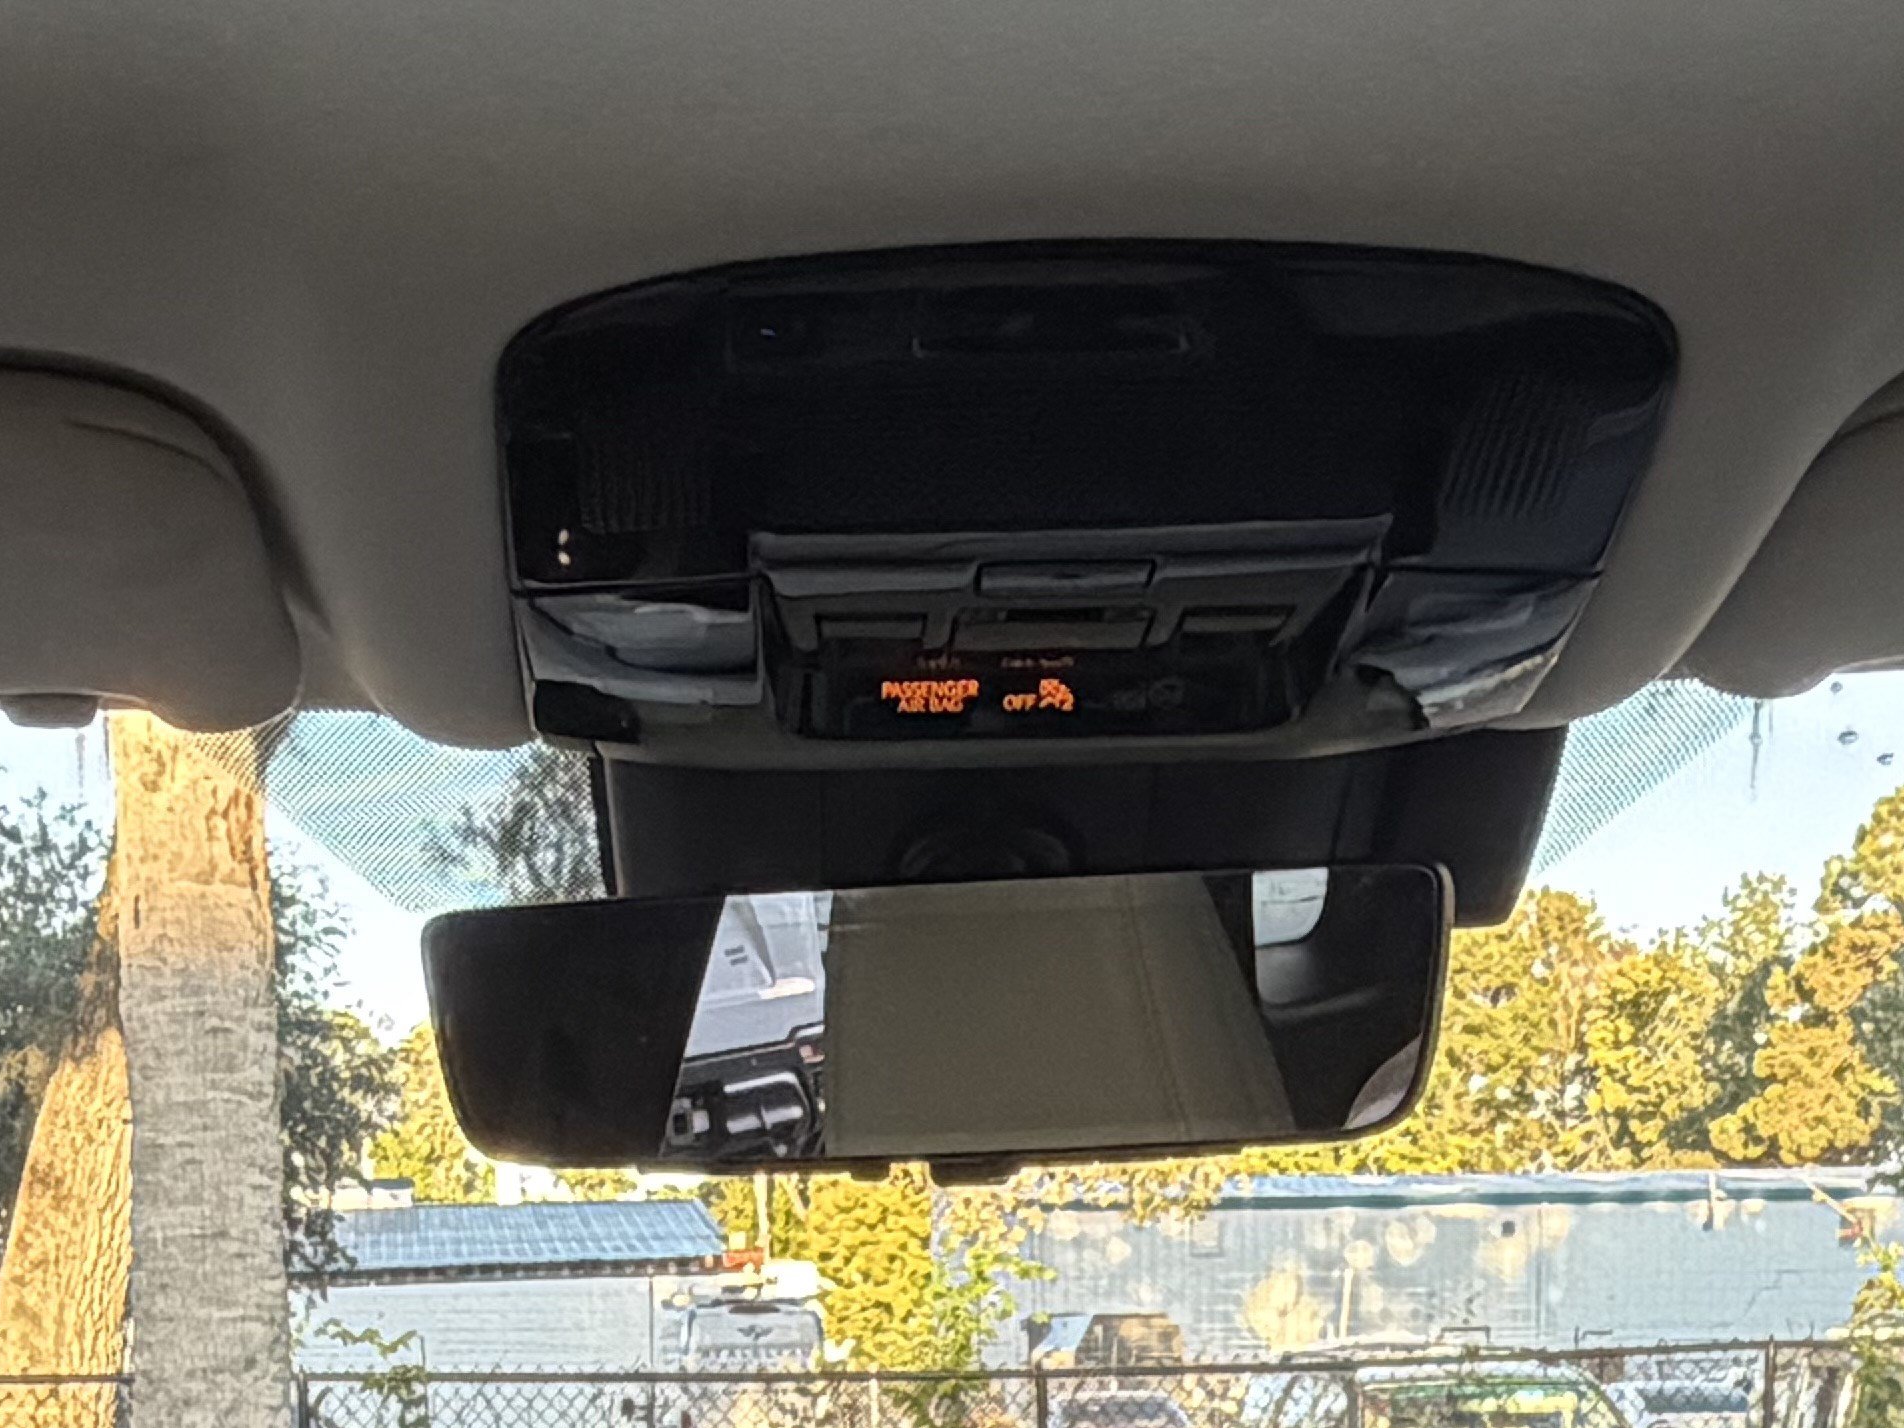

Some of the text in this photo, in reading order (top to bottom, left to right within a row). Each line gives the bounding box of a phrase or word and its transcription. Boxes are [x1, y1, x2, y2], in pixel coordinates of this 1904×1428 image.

[881, 679, 980, 699] PASSENGER
[897, 697, 926, 713] AIR
[1002, 694, 1037, 711] OFF
